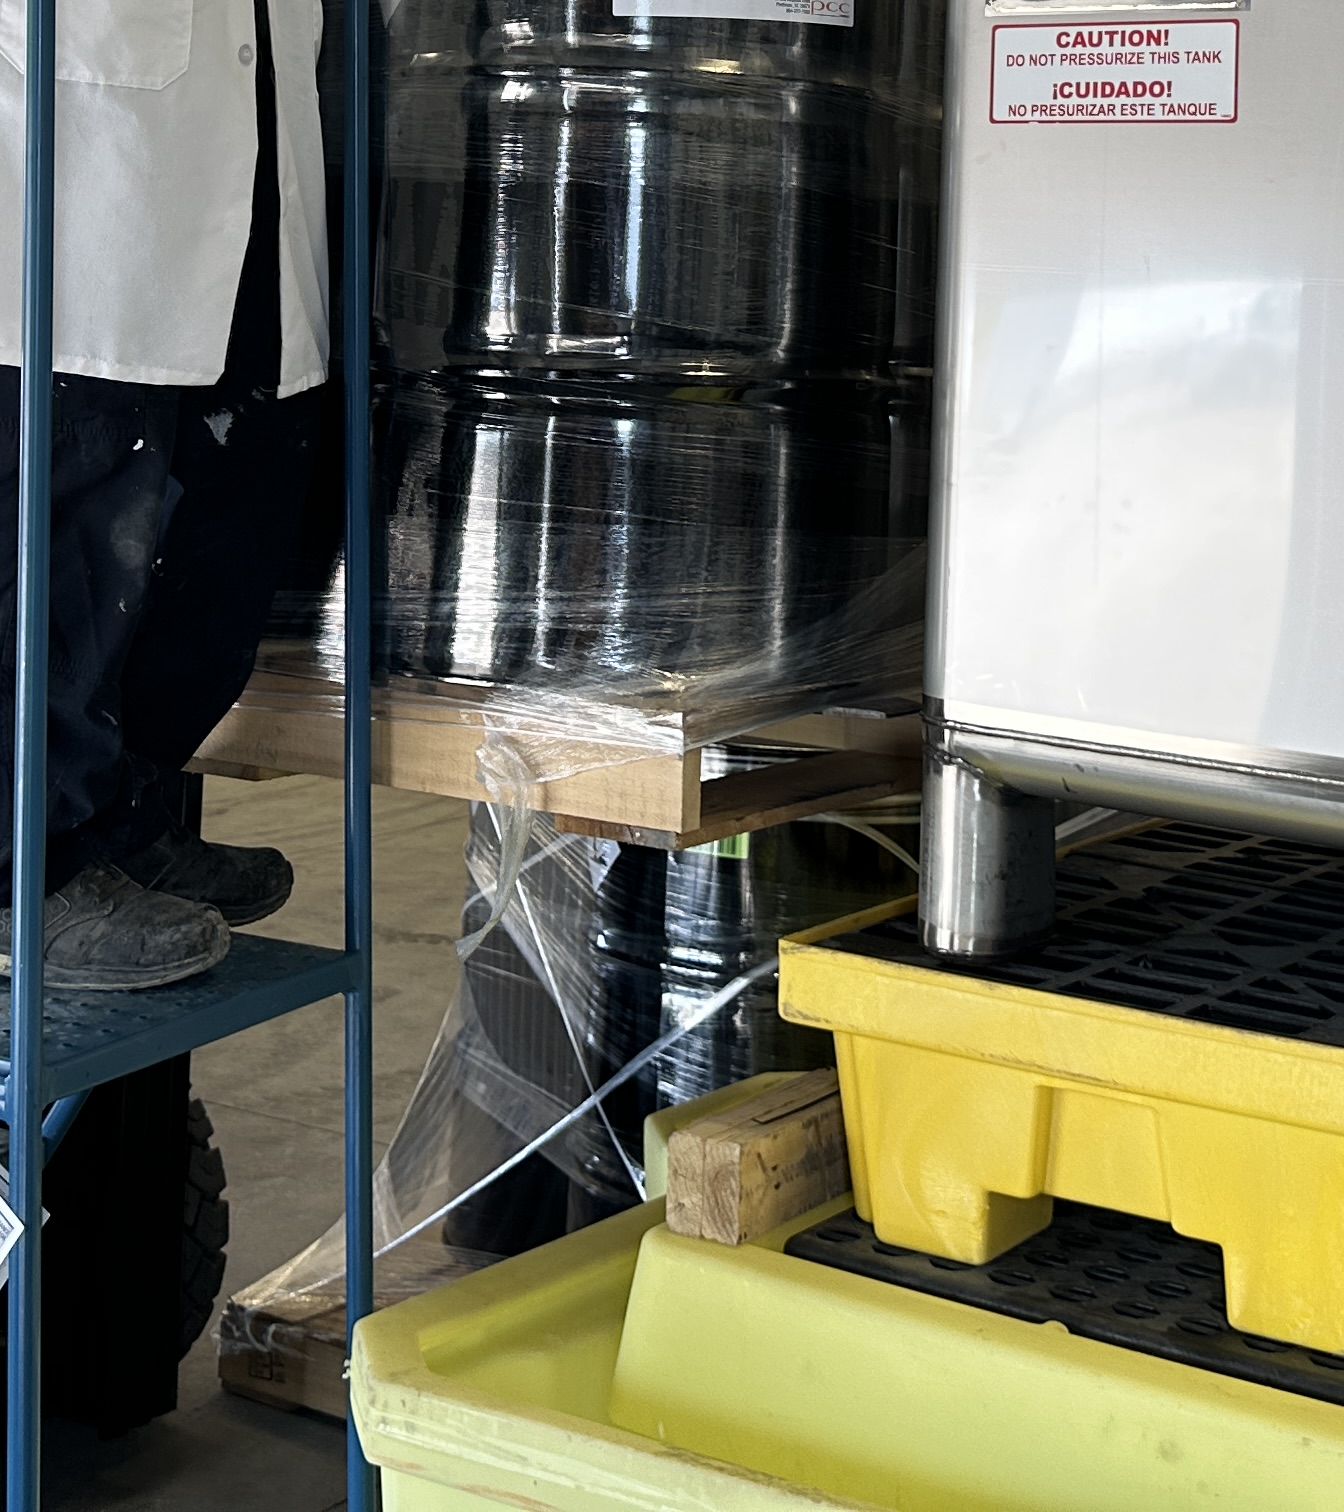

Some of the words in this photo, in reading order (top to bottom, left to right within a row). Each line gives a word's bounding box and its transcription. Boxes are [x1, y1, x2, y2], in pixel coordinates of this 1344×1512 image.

[811, 0, 850, 15] pcc
[1055, 29, 1169, 48] CAUTION!
[1006, 54, 1025, 67] DO
[1029, 53, 1056, 66] NOT
[1059, 52, 1145, 66] PRESSURIZE
[1149, 51, 1180, 64] THIS
[1184, 50, 1222, 64] TANK
[1052, 80, 1172, 100] ¡CUIDADO!
[1008, 104, 1027, 117] NO
[1030, 103, 1116, 117] PRESURIZAR
[1120, 103, 1155, 116] ESTE
[1159, 103, 1217, 117] TANQUE
